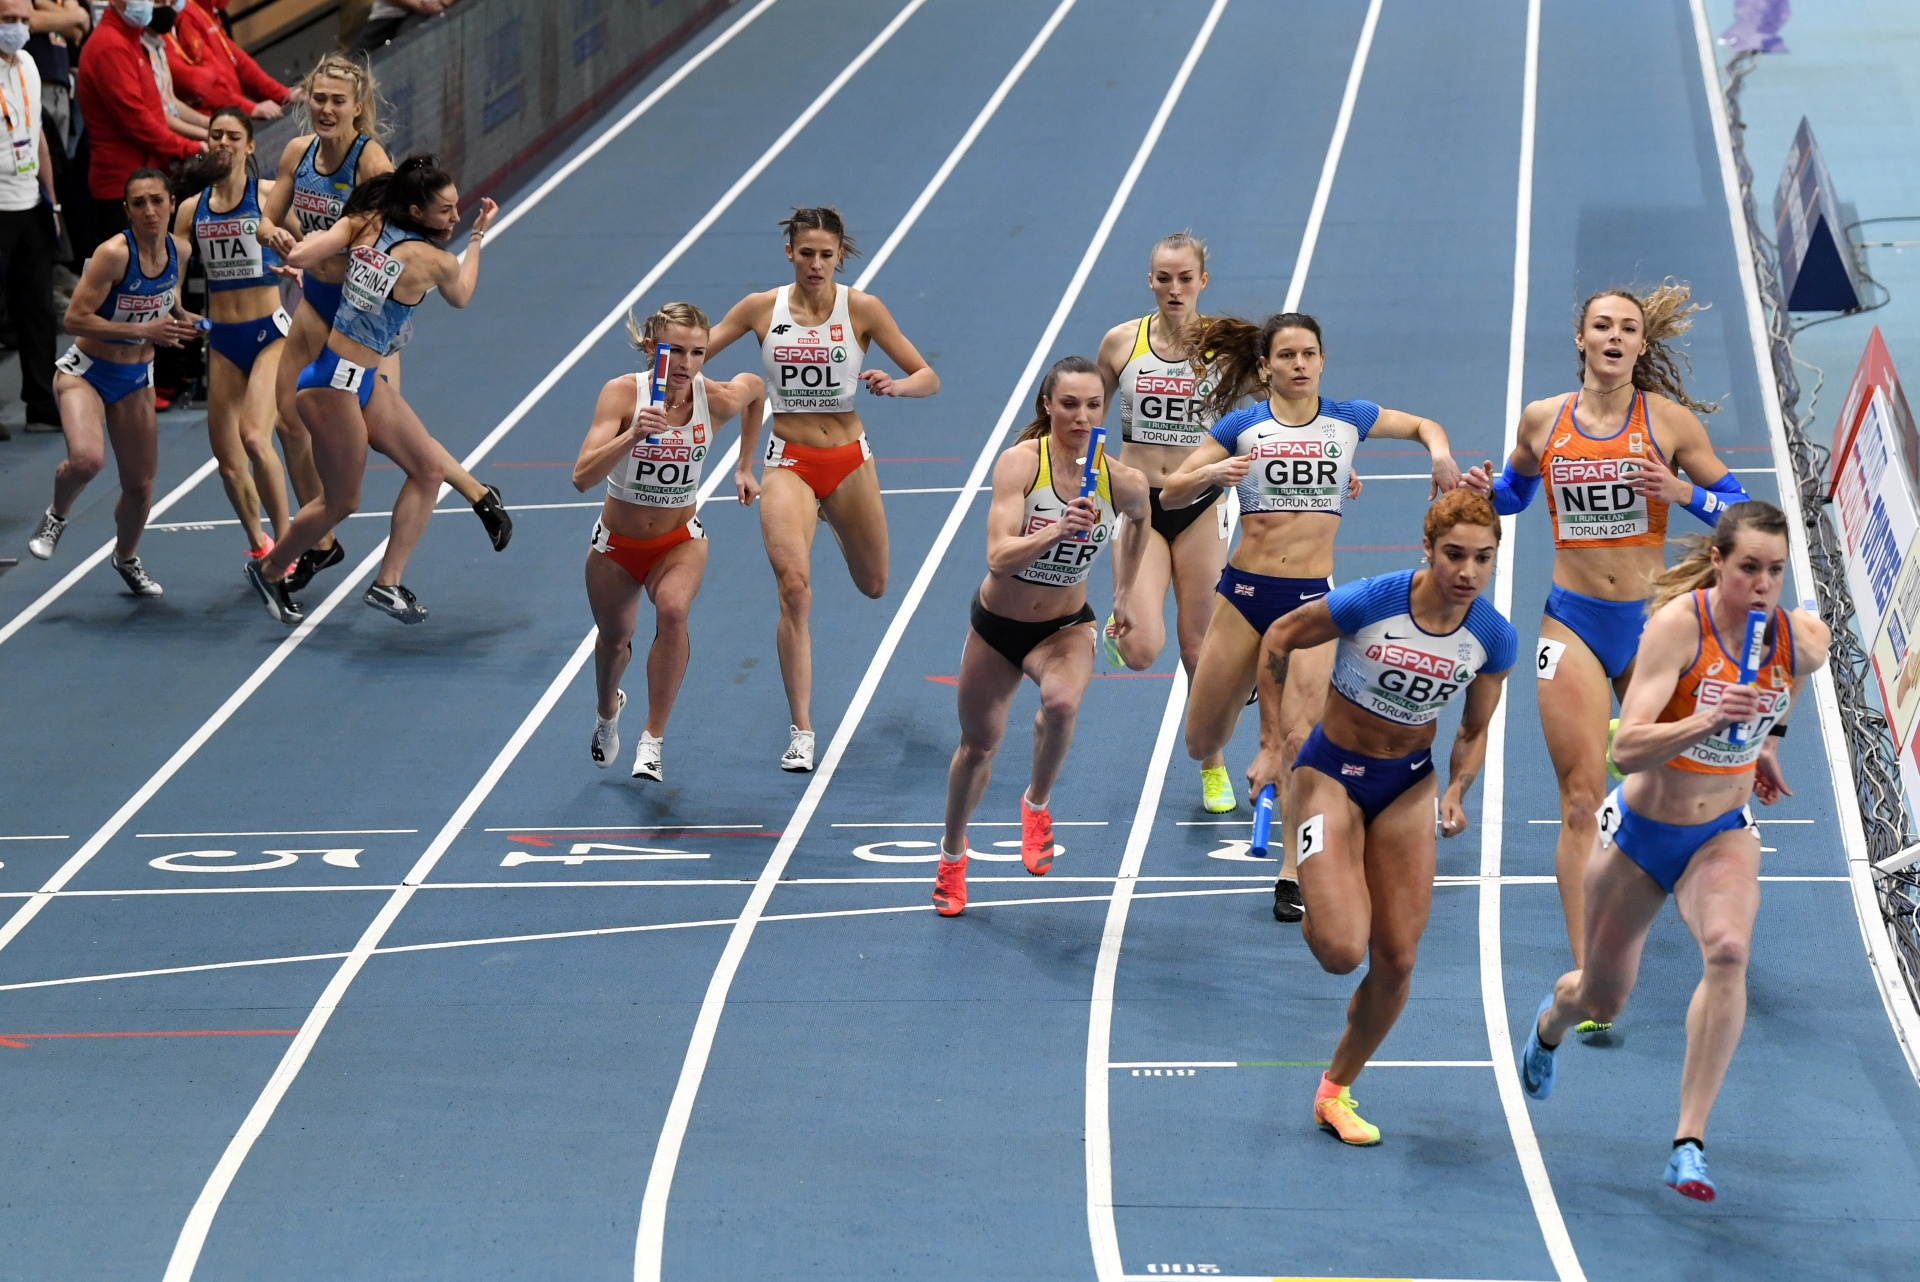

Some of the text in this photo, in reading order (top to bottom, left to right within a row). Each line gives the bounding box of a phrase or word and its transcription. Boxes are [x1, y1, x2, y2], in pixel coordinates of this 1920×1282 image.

[294, 196, 327, 212] SPAR
[197, 222, 240, 237] SPAR
[209, 238, 248, 260] ITA
[237, 267, 255, 276] 2021
[118, 297, 162, 310] SPAR
[355, 297, 373, 311] 2021
[771, 323, 792, 335] 4F
[775, 347, 829, 362] SPAR
[345, 367, 357, 388] 1
[781, 365, 841, 388] POL
[1137, 379, 1195, 394] SPAR
[783, 397, 840, 408] TORUŃ 2021
[1140, 396, 1207, 423] GER
[1170, 424, 1195, 432] CLEAN
[1142, 431, 1201, 444] TORUŃ 2021
[633, 447, 690, 461] SPAR
[766, 440, 775, 460] 3
[1262, 442, 1322, 456] SPAR
[635, 460, 694, 486] POL
[1264, 460, 1338, 486] GBR
[1553, 464, 1618, 482] SPAR
[644, 485, 661, 493] RUN
[662, 486, 685, 494] CLEAN
[1561, 484, 1636, 512] NED
[634, 492, 689, 505] TORUŃ 2021
[1270, 497, 1332, 508] TORUŃ 2021
[1579, 514, 1597, 522] RUN
[1598, 512, 1625, 522] CLEAN
[1569, 523, 1637, 536] TORUŃ 2021
[1859, 493, 1890, 576] TOYO
[1037, 542, 1099, 567] ER
[1024, 569, 1062, 583] TORUŃ
[1036, 562, 1053, 570] RUN
[1053, 564, 1081, 574] CLEAN
[1870, 528, 1902, 617] TIRES
[1385, 647, 1453, 680] SPAR
[1538, 645, 1551, 671] 6
[1378, 669, 1459, 703] GBR
[1371, 697, 1413, 721] TORUŃ
[1602, 807, 1614, 832] 6
[1302, 824, 1313, 855] 5
[149, 848, 365, 874] 5
[500, 842, 712, 868] 4
